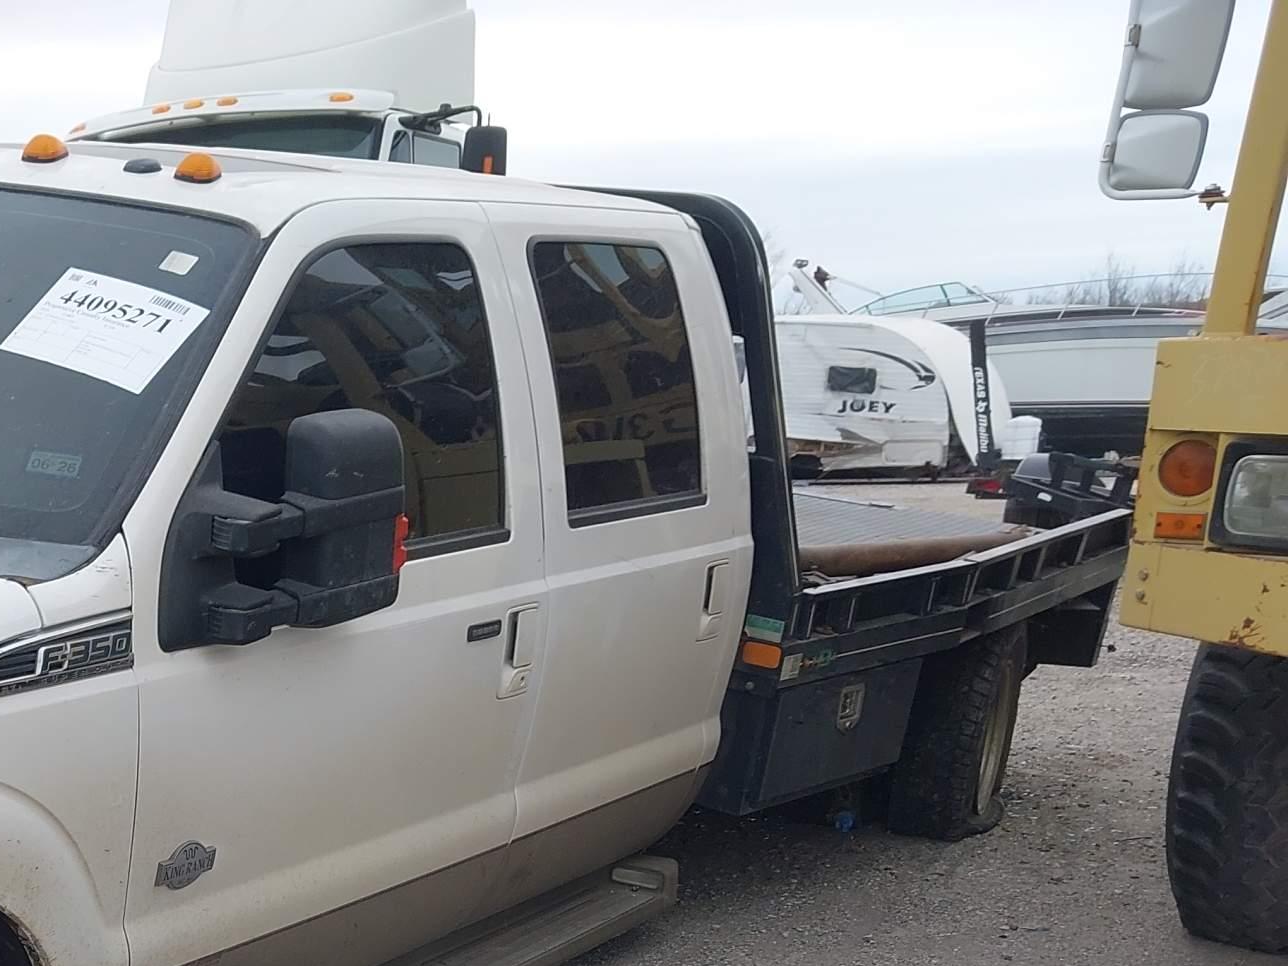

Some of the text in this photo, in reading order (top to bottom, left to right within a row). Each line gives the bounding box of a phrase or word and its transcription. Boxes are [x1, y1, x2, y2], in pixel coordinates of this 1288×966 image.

[60, 289, 173, 333] 44095271
[974, 366, 987, 399] TEXAS
[838, 399, 897, 414] JOEY
[37, 630, 132, 675] F-350
